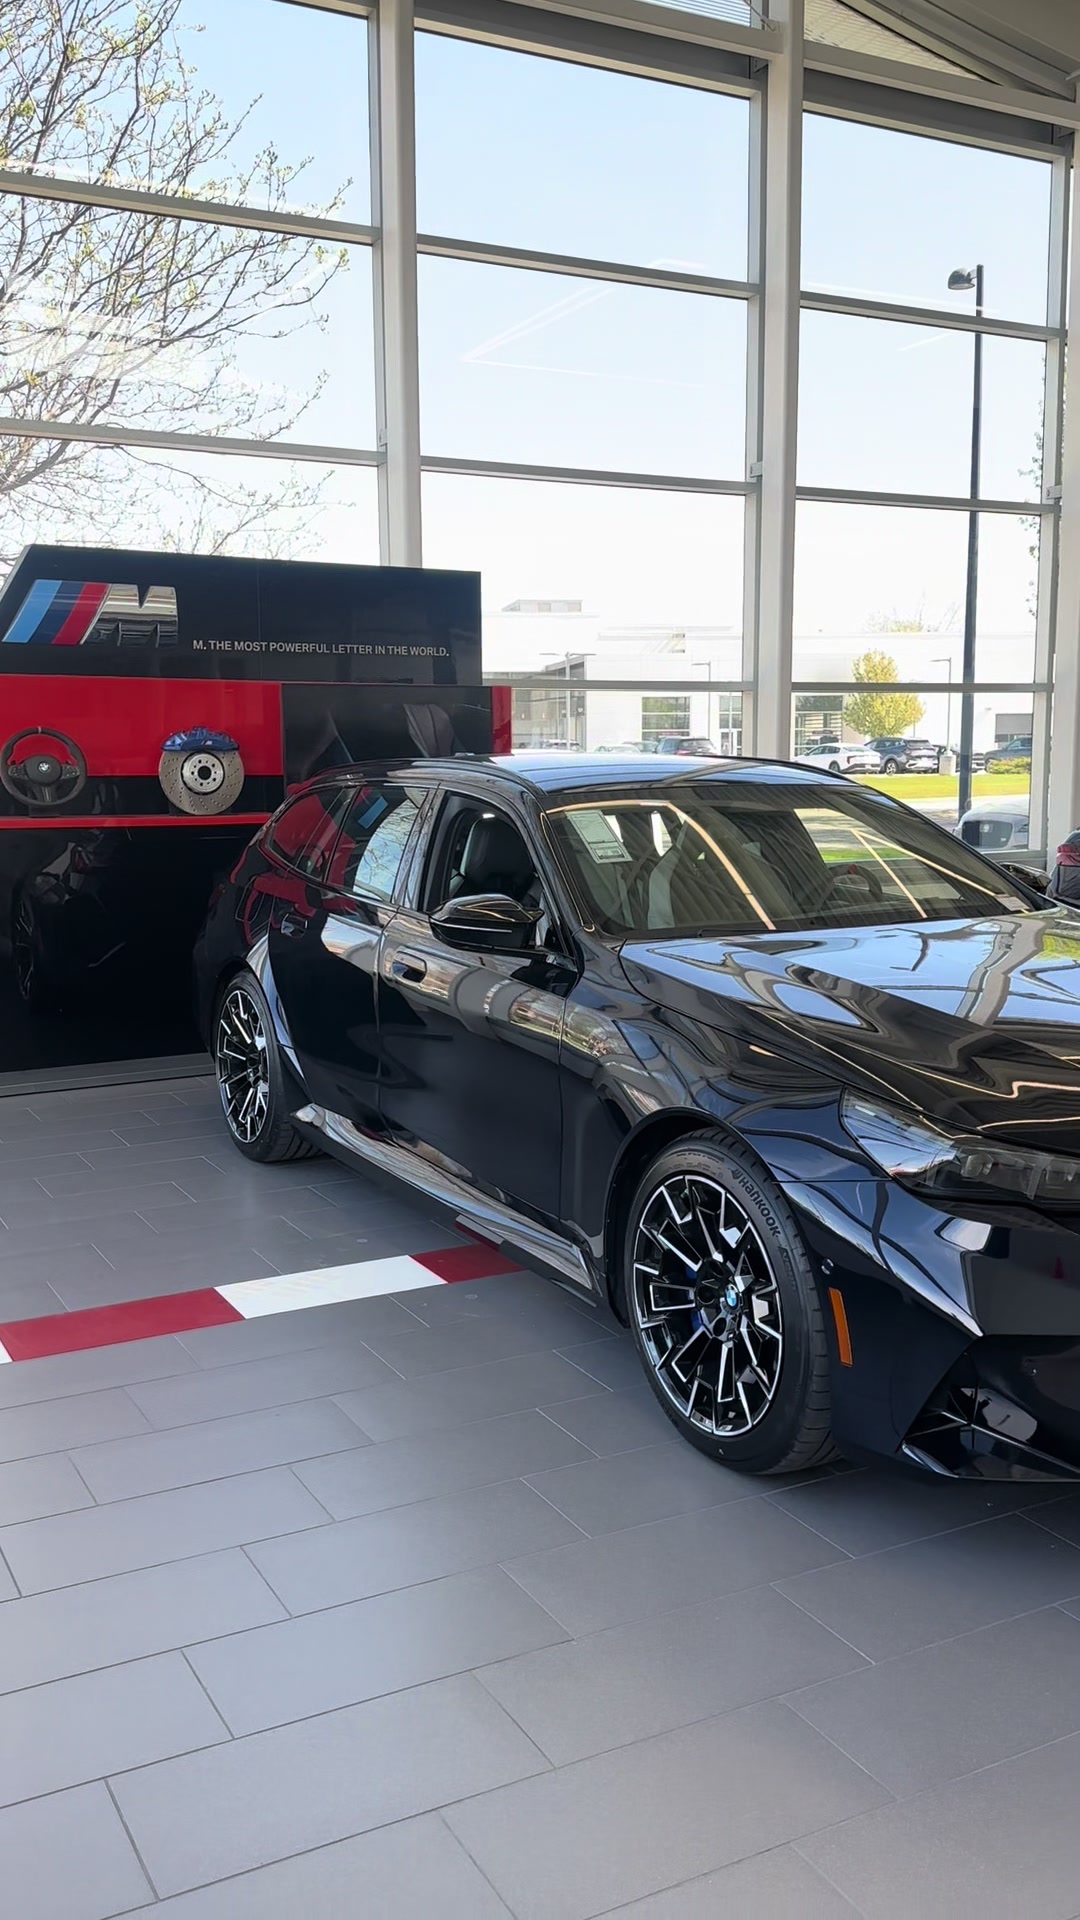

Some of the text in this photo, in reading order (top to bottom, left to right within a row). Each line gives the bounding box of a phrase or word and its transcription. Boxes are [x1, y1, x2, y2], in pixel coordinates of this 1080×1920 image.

[79, 582, 178, 648] M
[193, 639, 450, 657] M. THE MOST POWERFUL LETTER IN THE WORLD.
